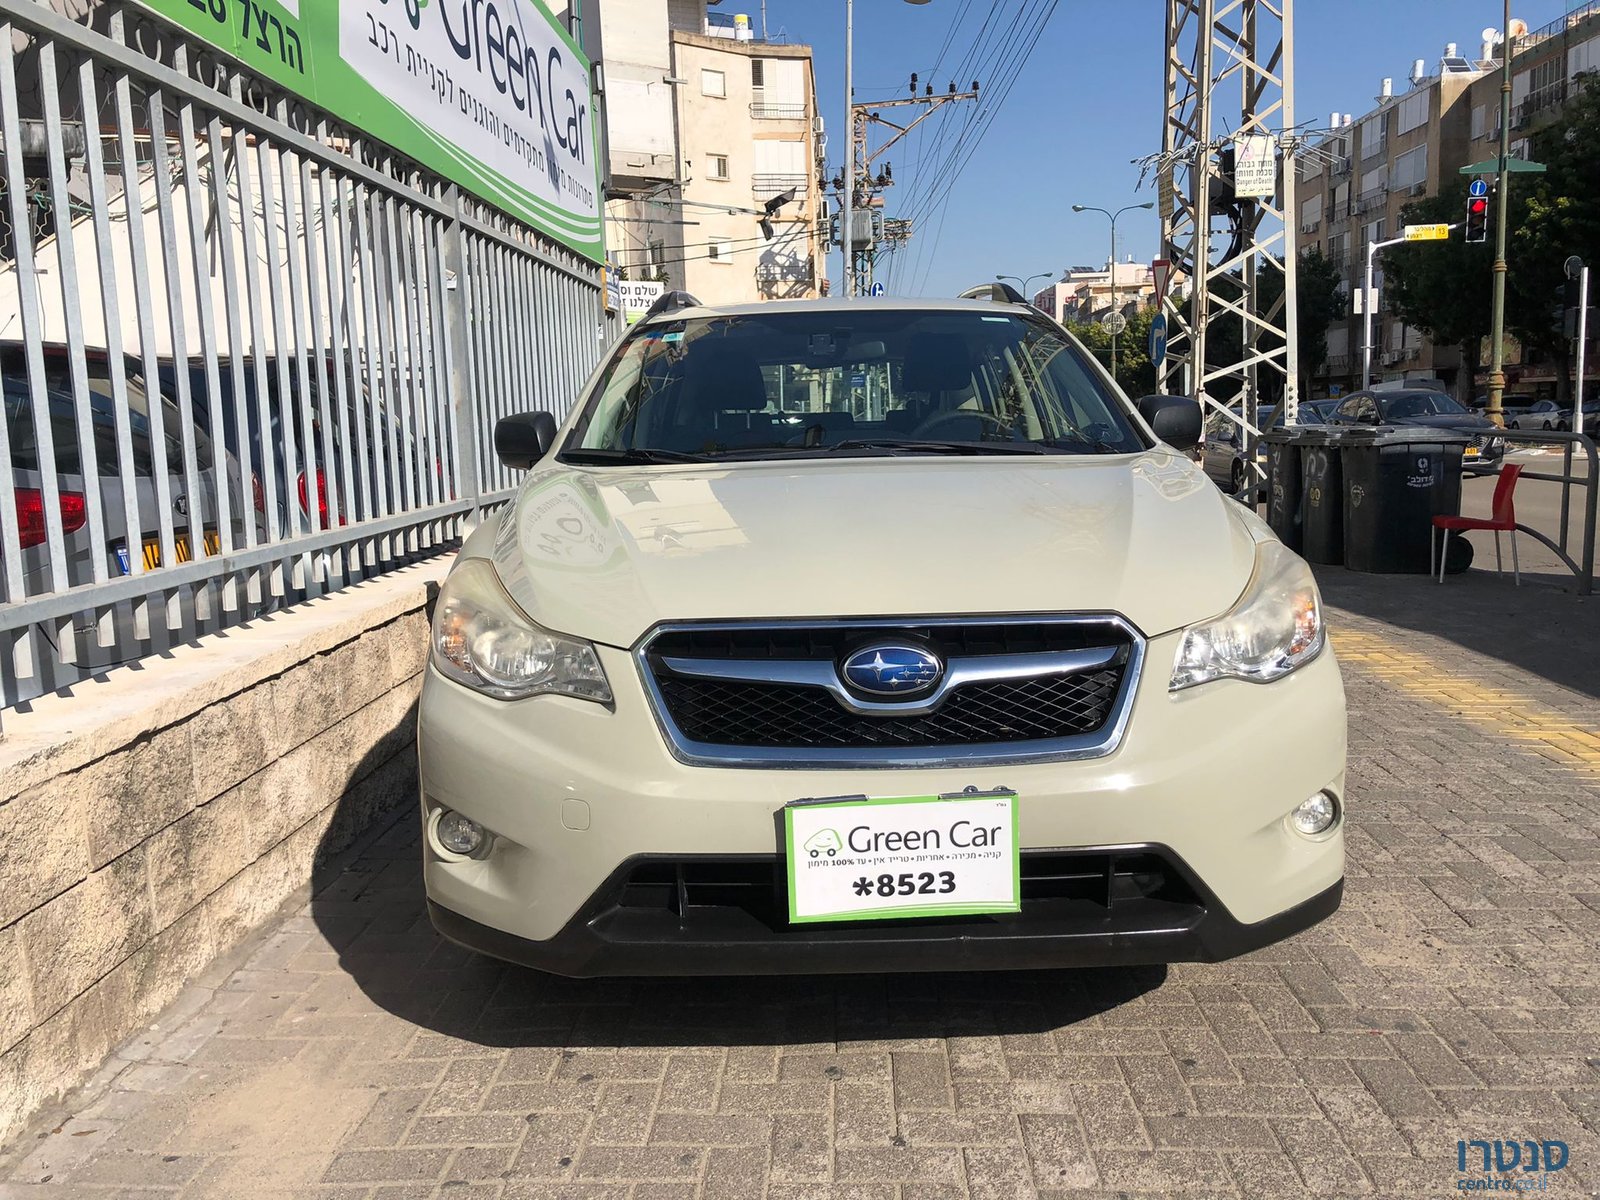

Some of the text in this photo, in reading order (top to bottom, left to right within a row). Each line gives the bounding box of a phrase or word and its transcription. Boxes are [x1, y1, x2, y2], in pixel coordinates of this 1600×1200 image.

[366, 12, 400, 64] רכב
[405, 44, 454, 104] לקניית
[459, 87, 500, 139] והוגנים
[547, 46, 586, 166] Car
[503, 123, 545, 173] מתקדמים
[567, 175, 593, 209] פתרונות
[620, 285, 658, 296] שלם וס
[630, 297, 656, 308] צלנו
[848, 820, 1002, 853] Green Car
[807, 850, 1002, 869] קניה מכירה אחריות טרייד אין עד 100% מימון
